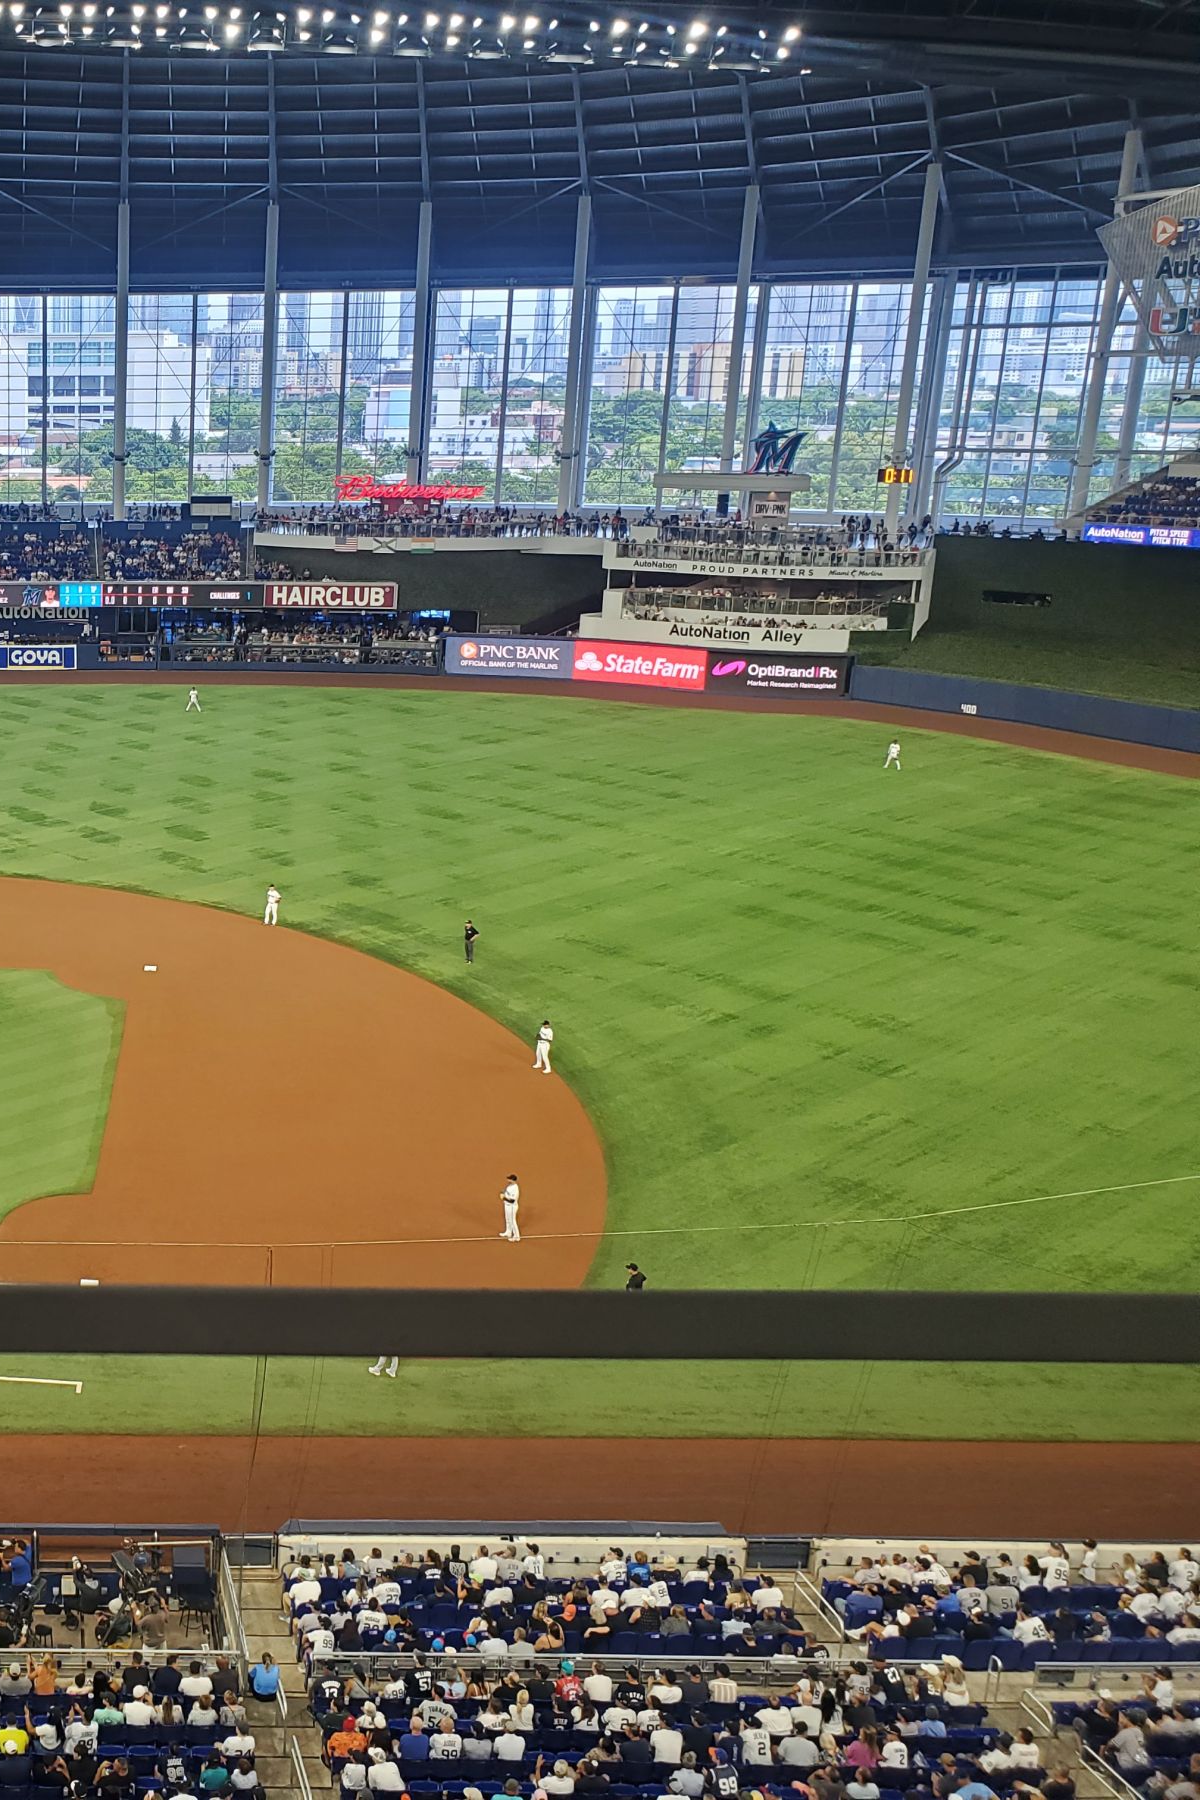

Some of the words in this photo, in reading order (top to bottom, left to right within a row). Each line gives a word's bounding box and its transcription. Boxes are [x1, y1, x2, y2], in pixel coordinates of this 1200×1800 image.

[885, 468, 914, 484] 0:11
[335, 475, 487, 500] Budweiser
[1087, 527, 1144, 539] AutoNation
[1149, 529, 1168, 537] PITCH
[633, 559, 677, 570] AutoNation
[692, 564, 736, 575] PROUD
[743, 566, 815, 577] PARTNERS
[65, 596, 70, 605] 2
[79, 596, 83, 605] 1
[91, 596, 96, 605] 3
[105, 596, 115, 605] 0.0
[123, 596, 127, 605] 0
[138, 596, 142, 605] 0
[152, 596, 157, 605] 0
[167, 596, 172, 605] 0
[182, 596, 187, 605] 0
[209, 592, 240, 600] CHALLENGES
[272, 586, 385, 607] HAIRCLUB
[669, 623, 750, 641] AutoNation
[762, 629, 804, 646] Alley
[11, 650, 60, 666] GOYA
[480, 645, 514, 659] PNC
[516, 647, 560, 660] BANK
[460, 660, 487, 668] OFFICIAL
[747, 680, 771, 688] Market
[772, 680, 798, 689] Research
[799, 681, 837, 690] Reimagined
[961, 703, 977, 715] 400
[1001, 1598, 1014, 1610] 51
[884, 1667, 900, 1684] 27
[419, 1678, 432, 1692] 51
[758, 1742, 767, 1756] 2
[166, 1766, 185, 1783] 99
[719, 1776, 738, 1795] 99
